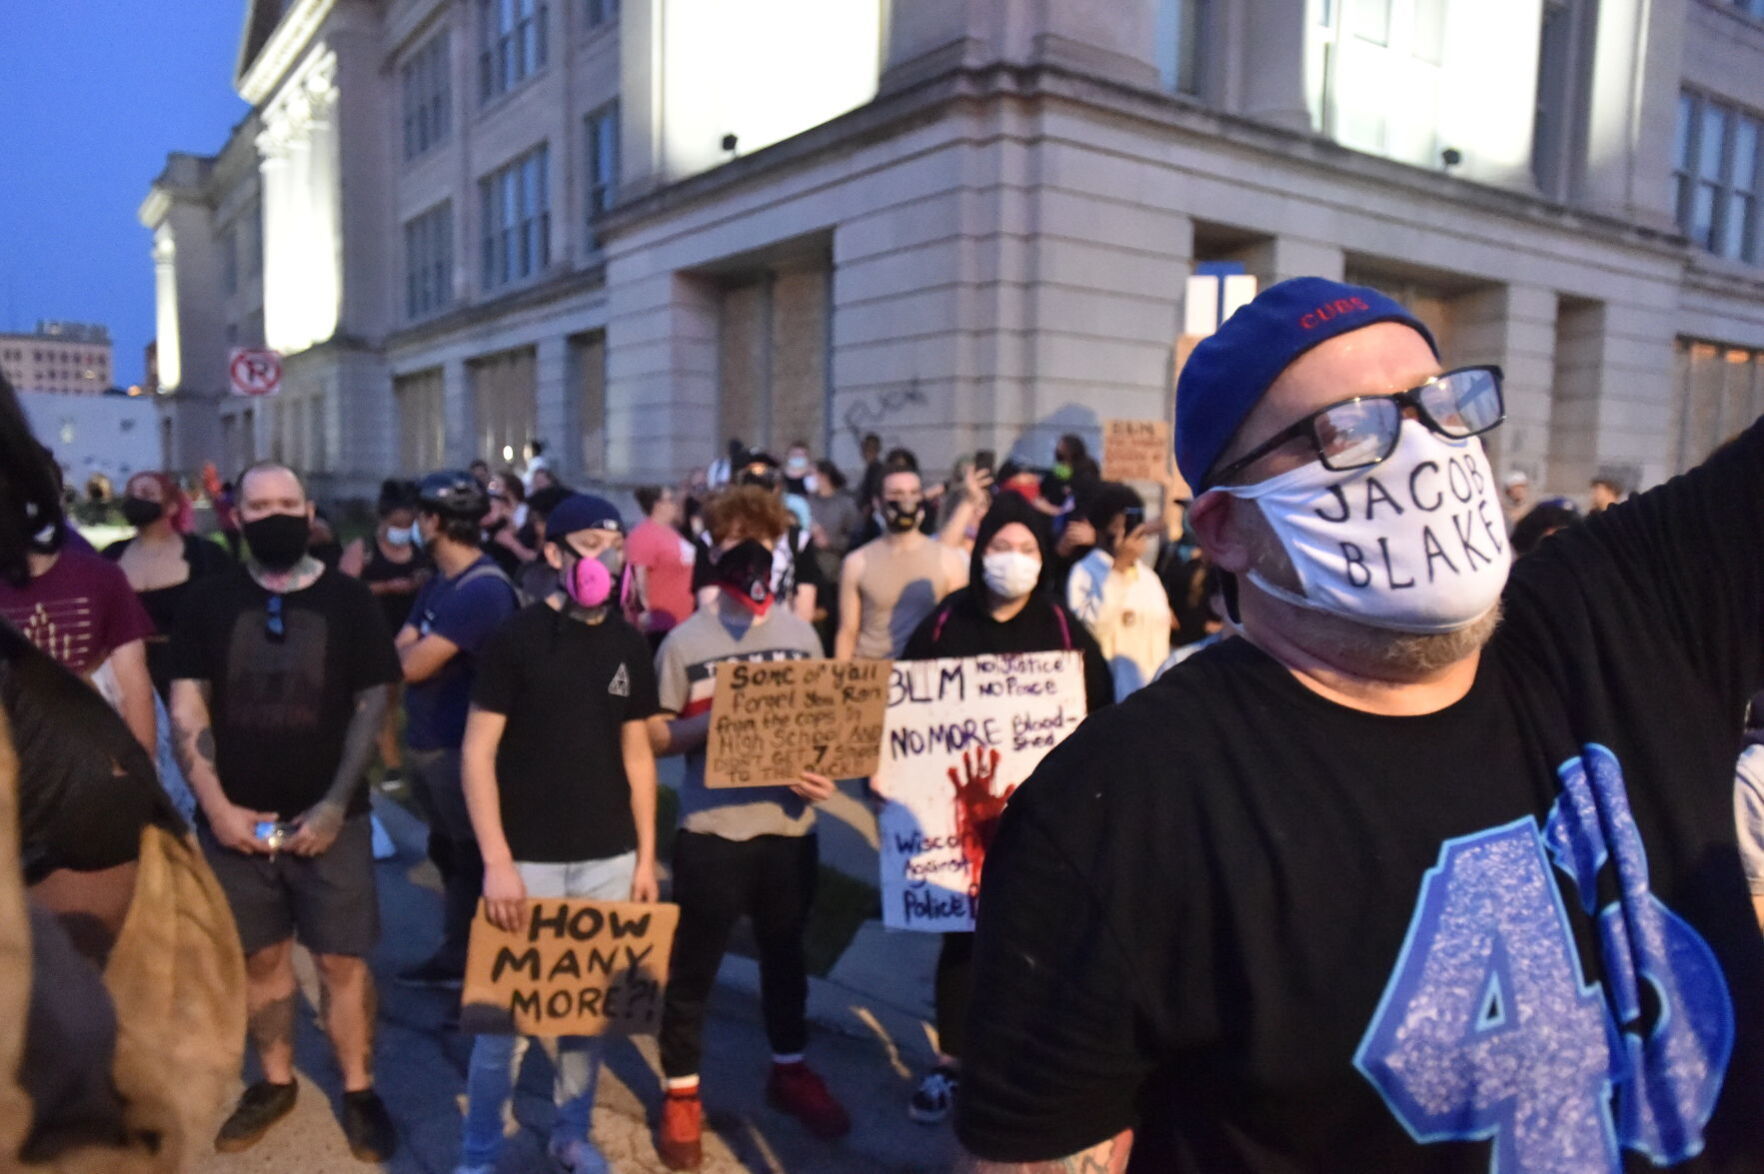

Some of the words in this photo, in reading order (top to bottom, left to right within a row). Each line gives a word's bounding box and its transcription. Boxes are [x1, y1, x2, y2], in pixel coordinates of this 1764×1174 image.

[1299, 296, 1369, 330] CUBS
[1314, 453, 1485, 524] JACOB
[1339, 500, 1502, 590] BLAKE
[812, 745, 830, 765] 7
[928, 718, 1001, 755] MORE
[528, 904, 652, 942] HOW
[903, 889, 967, 925] Police
[490, 943, 654, 984] MANY
